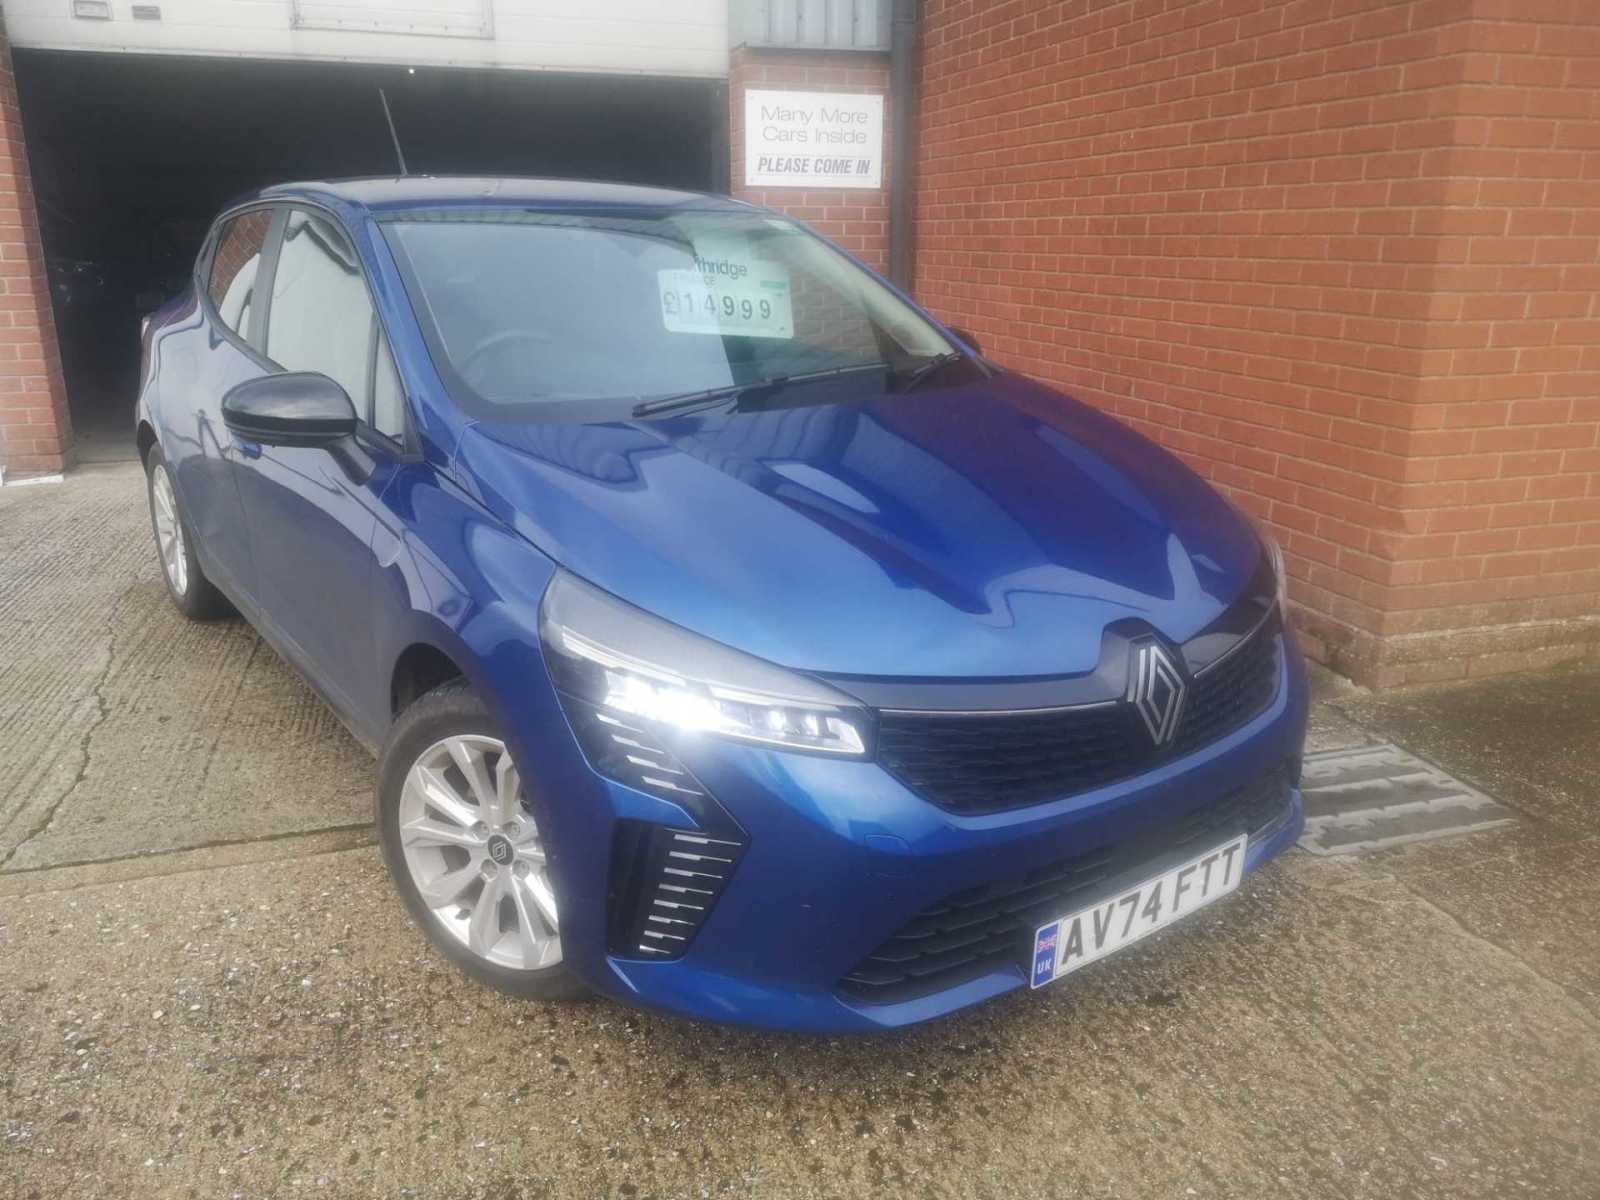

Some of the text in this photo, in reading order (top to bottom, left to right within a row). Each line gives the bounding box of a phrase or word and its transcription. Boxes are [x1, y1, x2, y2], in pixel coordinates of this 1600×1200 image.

[761, 105, 868, 125] Many More
[762, 126, 867, 144] Cars Inside
[758, 157, 871, 174] PLEASE COME IN
[1037, 959, 1051, 975] UK
